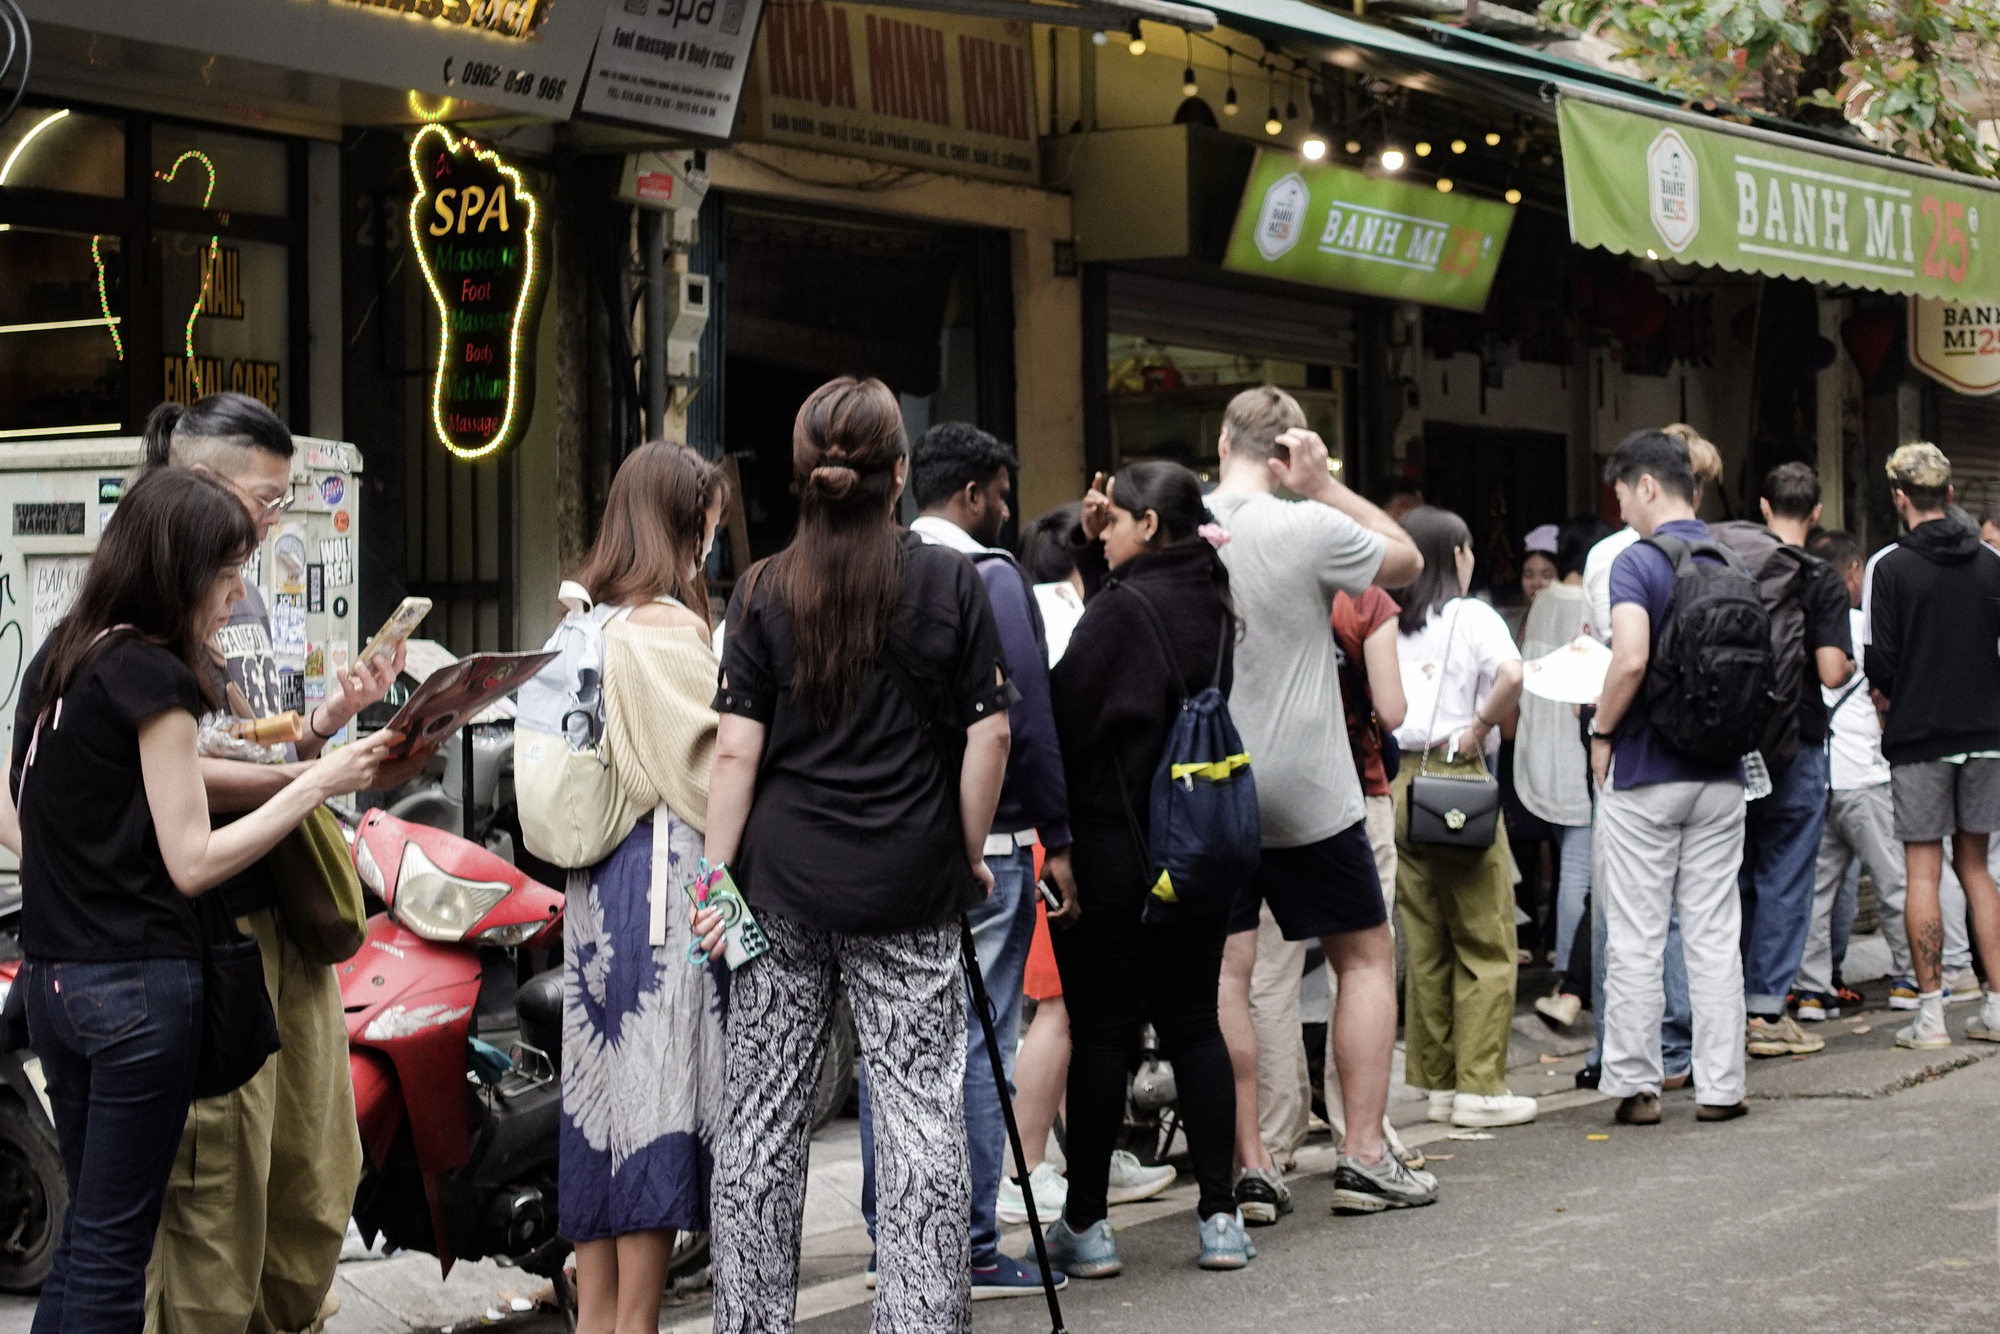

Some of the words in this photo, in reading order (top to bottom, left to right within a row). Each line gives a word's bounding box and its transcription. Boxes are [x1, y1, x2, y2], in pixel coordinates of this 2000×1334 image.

[865, 14, 950, 127] MINH
[958, 34, 1030, 142] KHAI
[429, 184, 509, 236] SPA
[1735, 170, 1850, 252] BANH
[1864, 196, 1915, 263] MI
[1921, 194, 1969, 284] 25
[1320, 209, 1403, 256] BANH
[1405, 226, 1448, 264] MI
[1442, 226, 1482, 277] 25
[435, 243, 519, 276] Massage
[200, 247, 244, 319] NAIL
[461, 278, 492, 303] Foot
[450, 307, 511, 336] Massage
[465, 343, 494, 365] Body
[449, 413, 499, 437] Massage
[15, 504, 66, 518] SUPPORT
[19, 517, 58, 532] NANUK
